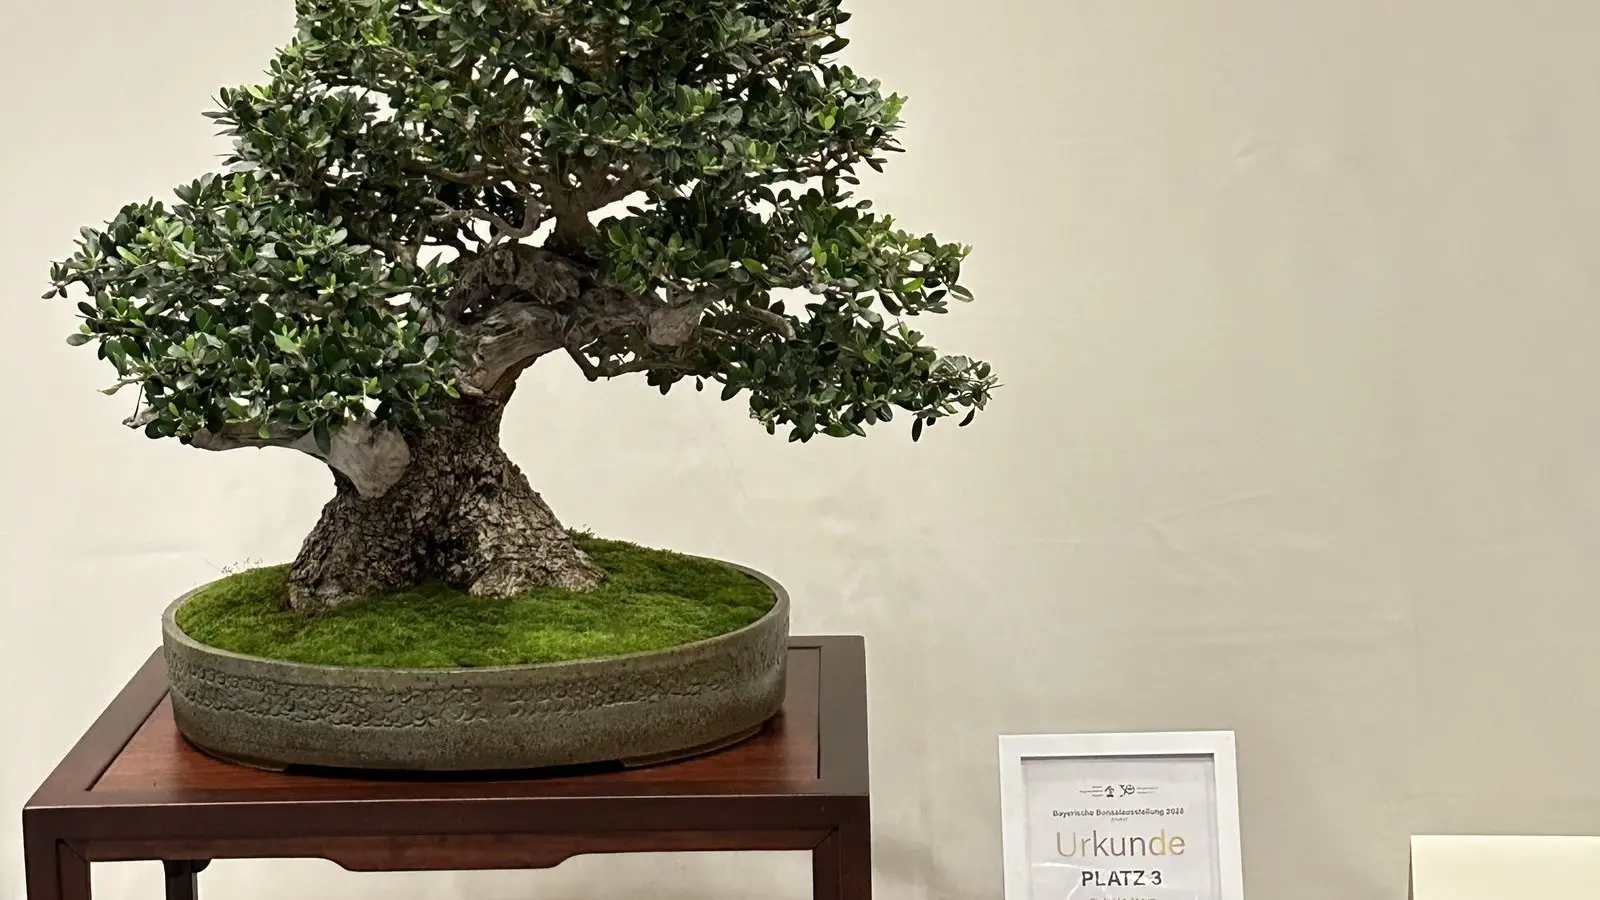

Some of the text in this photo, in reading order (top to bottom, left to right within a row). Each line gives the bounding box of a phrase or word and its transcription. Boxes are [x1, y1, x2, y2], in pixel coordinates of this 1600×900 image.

[1056, 829, 1186, 857] Urkunde
[1081, 870, 1162, 886] PLATZ 3
